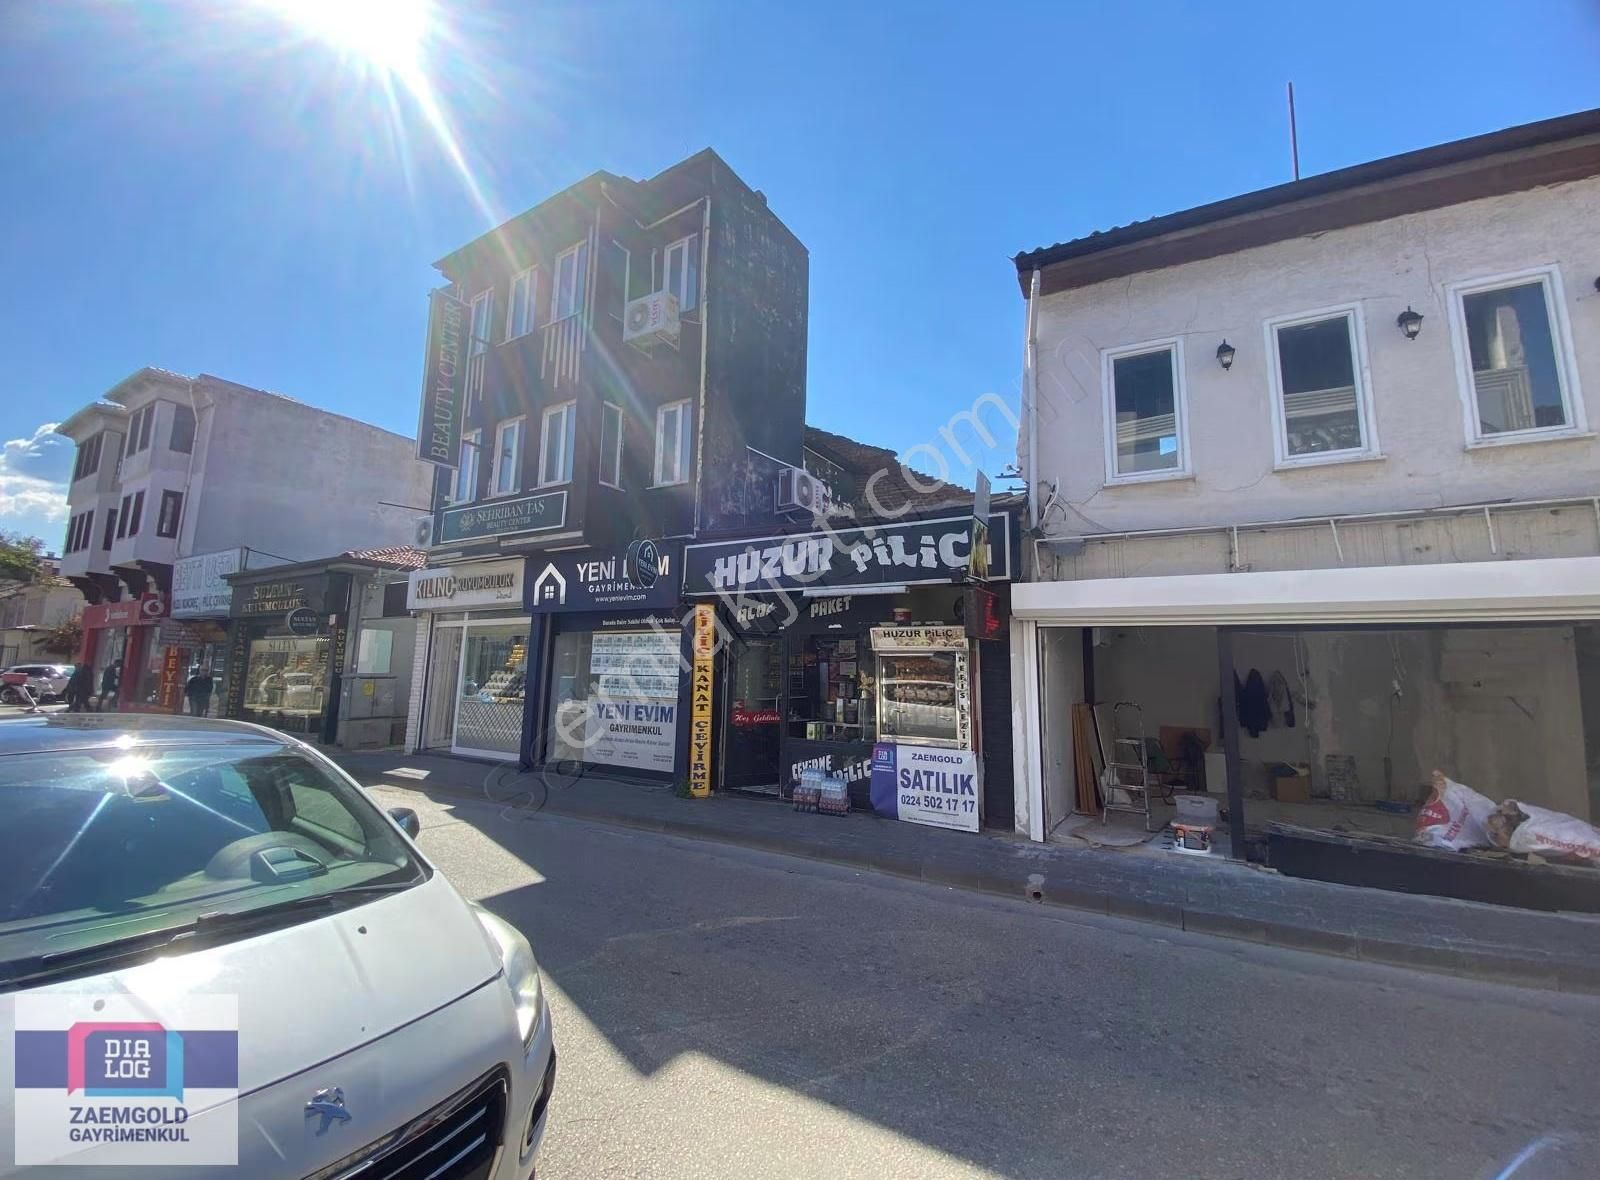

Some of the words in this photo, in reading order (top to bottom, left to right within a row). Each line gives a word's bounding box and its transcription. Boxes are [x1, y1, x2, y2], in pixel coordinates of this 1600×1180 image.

[432, 383, 454, 460] BEAUTY
[576, 556, 616, 582] YENİ
[714, 538, 832, 588] HUZUR
[810, 595, 852, 618] PAKET
[883, 630, 921, 638] HUZUR
[696, 665, 710, 712] KANAT
[596, 700, 630, 721] YENİ
[634, 701, 674, 723] EVİM
[911, 753, 963, 765] ZAEMGOLD
[900, 767, 975, 796] SATILIK
[901, 794, 921, 807] 0224
[923, 795, 943, 810] 502
[945, 798, 959, 812] 17
[962, 800, 976, 814] 17
